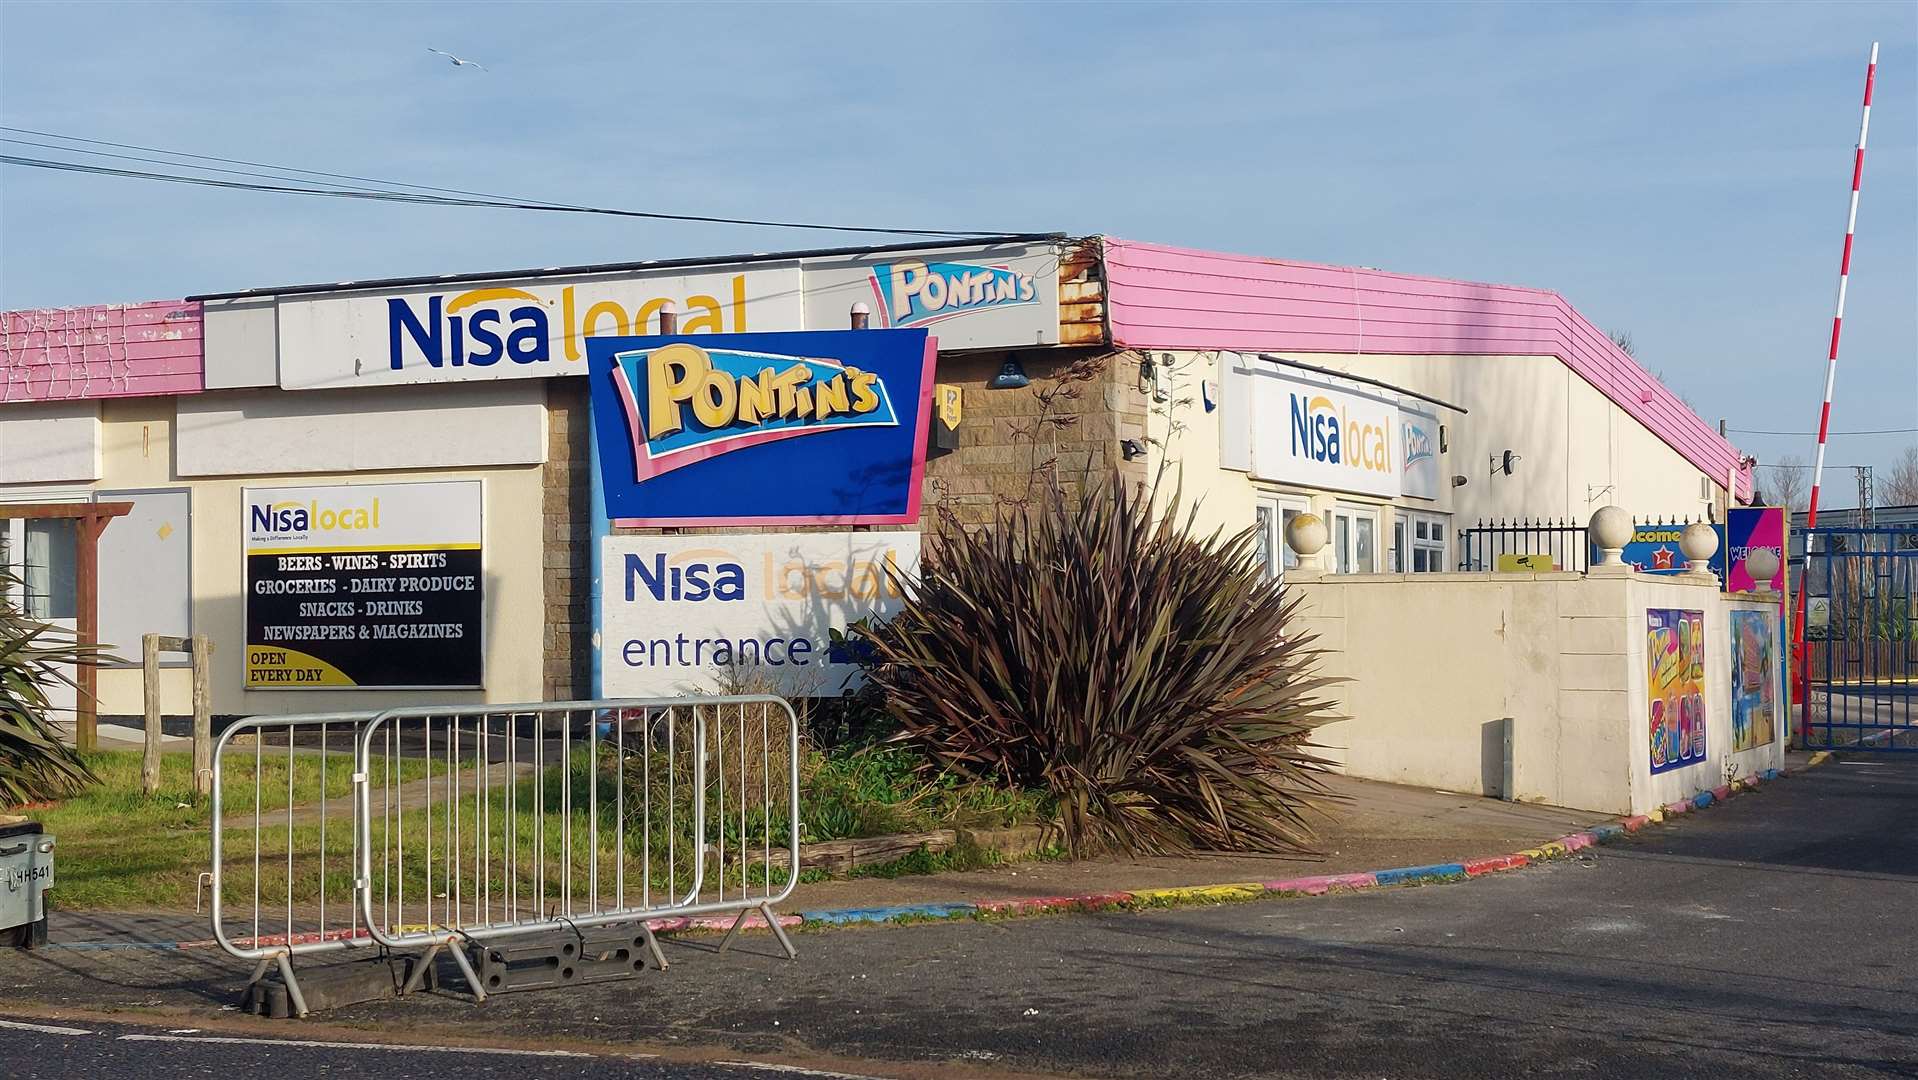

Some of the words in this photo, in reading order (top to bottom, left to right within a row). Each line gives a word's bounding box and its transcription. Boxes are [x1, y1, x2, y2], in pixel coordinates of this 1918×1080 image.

[387, 295, 550, 370] Nisa
[1290, 393, 1340, 464] Nisa
[1342, 405, 1392, 474] local
[251, 504, 309, 532] Nisa
[311, 497, 380, 531] local
[1631, 531, 1681, 543] lcome
[277, 555, 322, 571] BEERS
[331, 555, 379, 570] WINES
[389, 553, 447, 569] SPIRITS
[624, 552, 745, 601] Nisa
[762, 547, 901, 600] local
[255, 579, 336, 594] GROCERIES
[351, 577, 397, 593] DAIRY
[400, 576, 475, 592] PRODUCE
[299, 602, 355, 617] SNACKS
[366, 601, 423, 616] DRINKS
[263, 625, 355, 641] NEWSPAPERS
[359, 625, 370, 640] &
[373, 624, 463, 639] MAGAZINES
[251, 652, 287, 665] OPEN
[622, 633, 812, 667] entrance
[251, 669, 292, 682] EVERY
[296, 669, 323, 681] DAY
